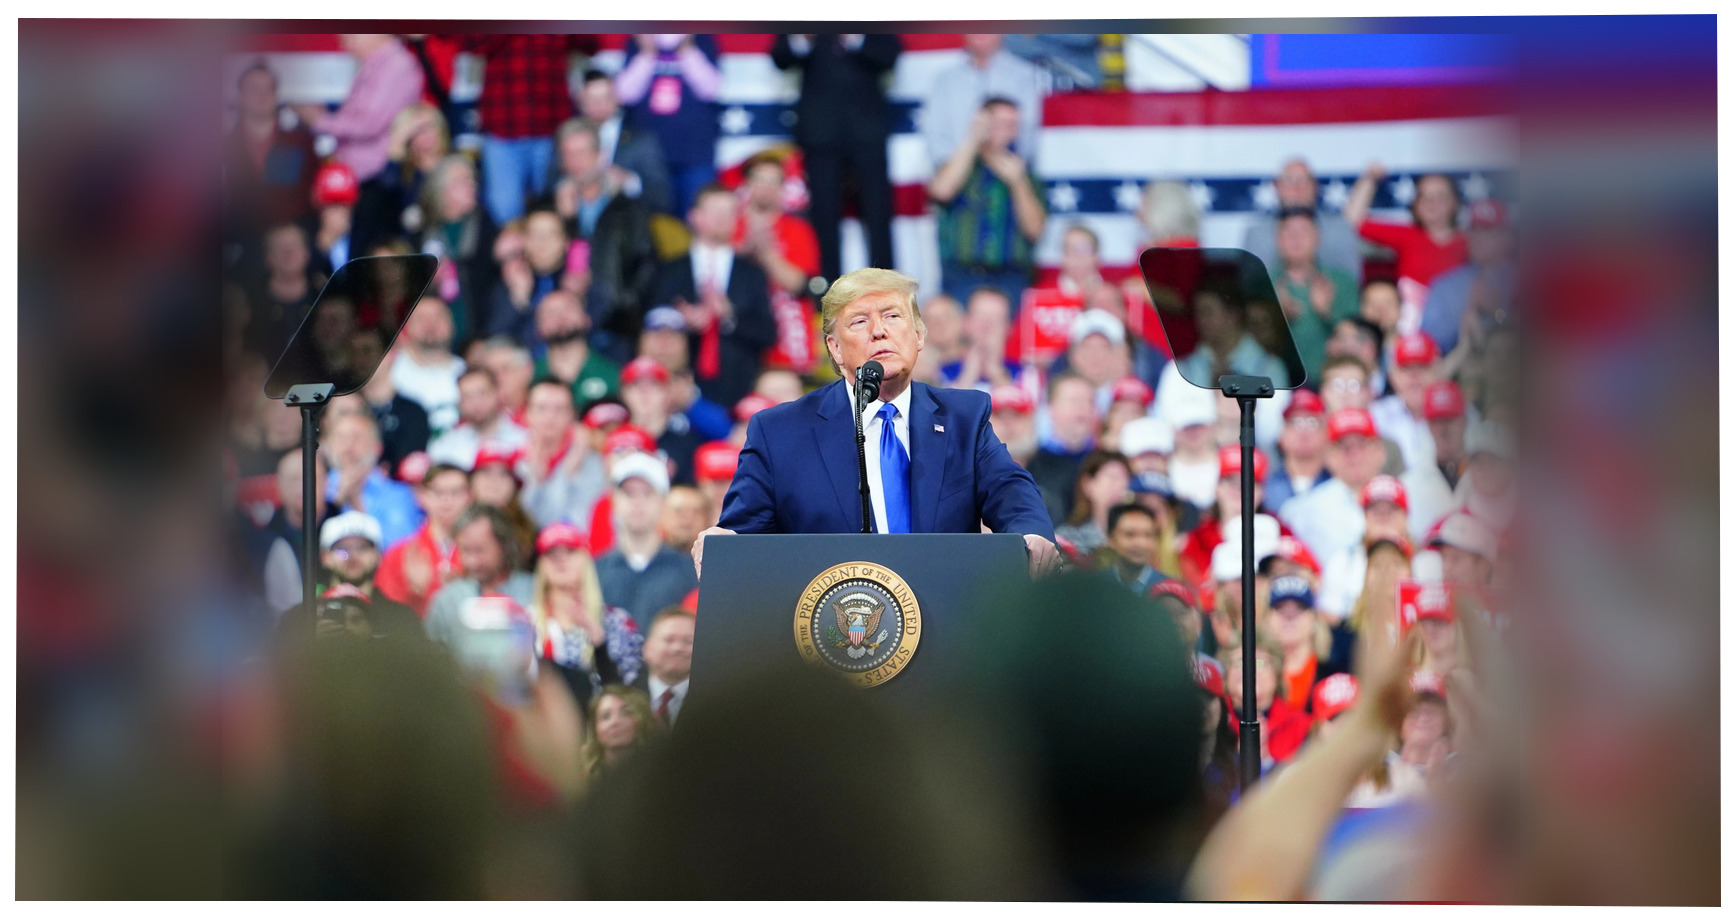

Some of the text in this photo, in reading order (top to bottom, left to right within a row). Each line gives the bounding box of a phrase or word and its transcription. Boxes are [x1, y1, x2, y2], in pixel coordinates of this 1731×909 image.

[862, 567, 874, 576] OF
[876, 571, 892, 584] THE
[800, 566, 859, 620] PRESIDENT
[893, 583, 917, 635] UNITED
[800, 625, 808, 642] THE
[865, 646, 910, 684] STATES
